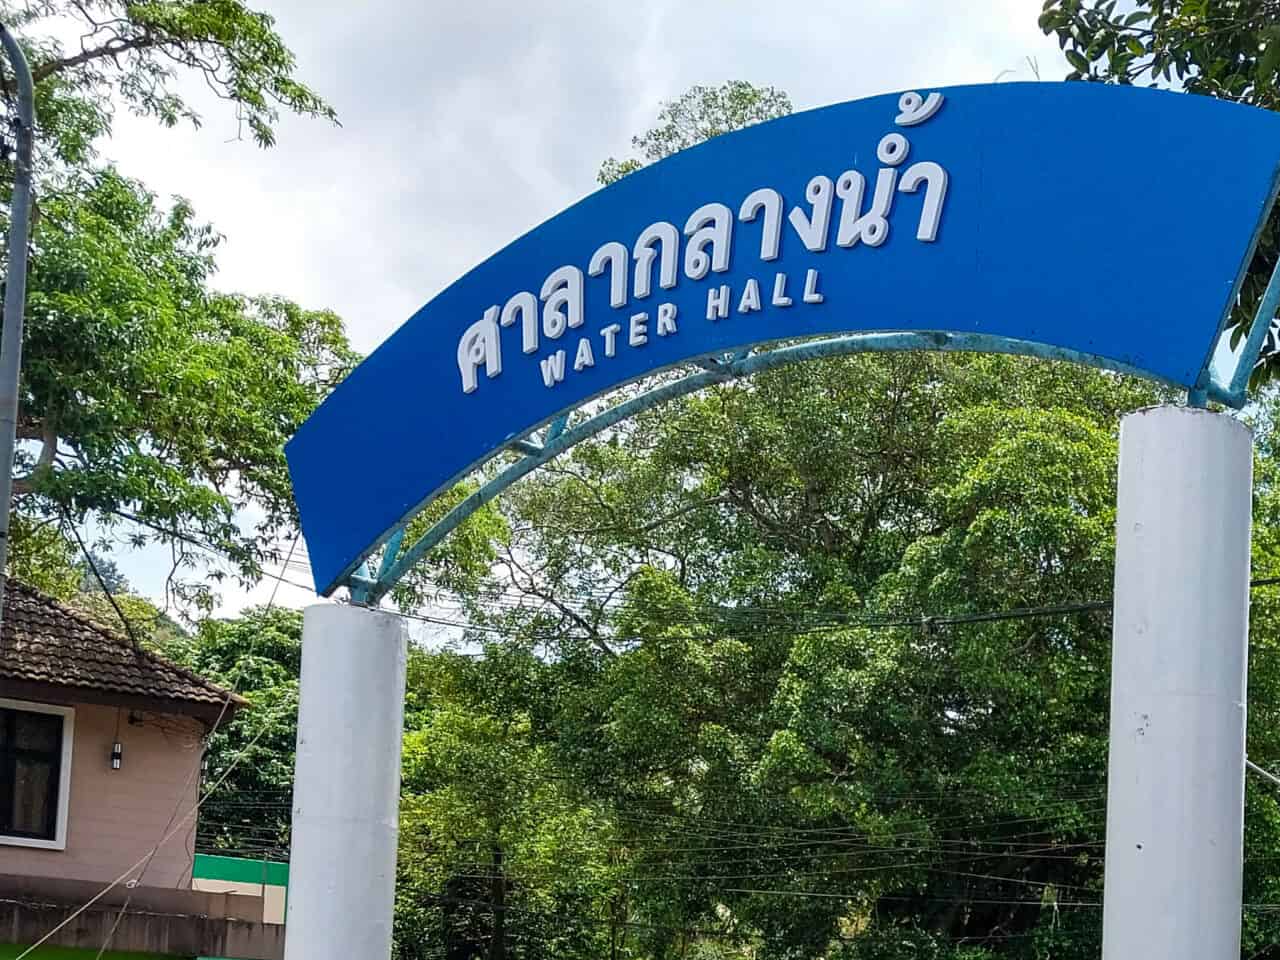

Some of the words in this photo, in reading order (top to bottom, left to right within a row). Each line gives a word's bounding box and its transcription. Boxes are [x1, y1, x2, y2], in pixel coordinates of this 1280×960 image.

[456, 90, 949, 395] ศาลากลางน้ำ
[540, 302, 679, 388] WATER
[706, 268, 826, 321] HALL
